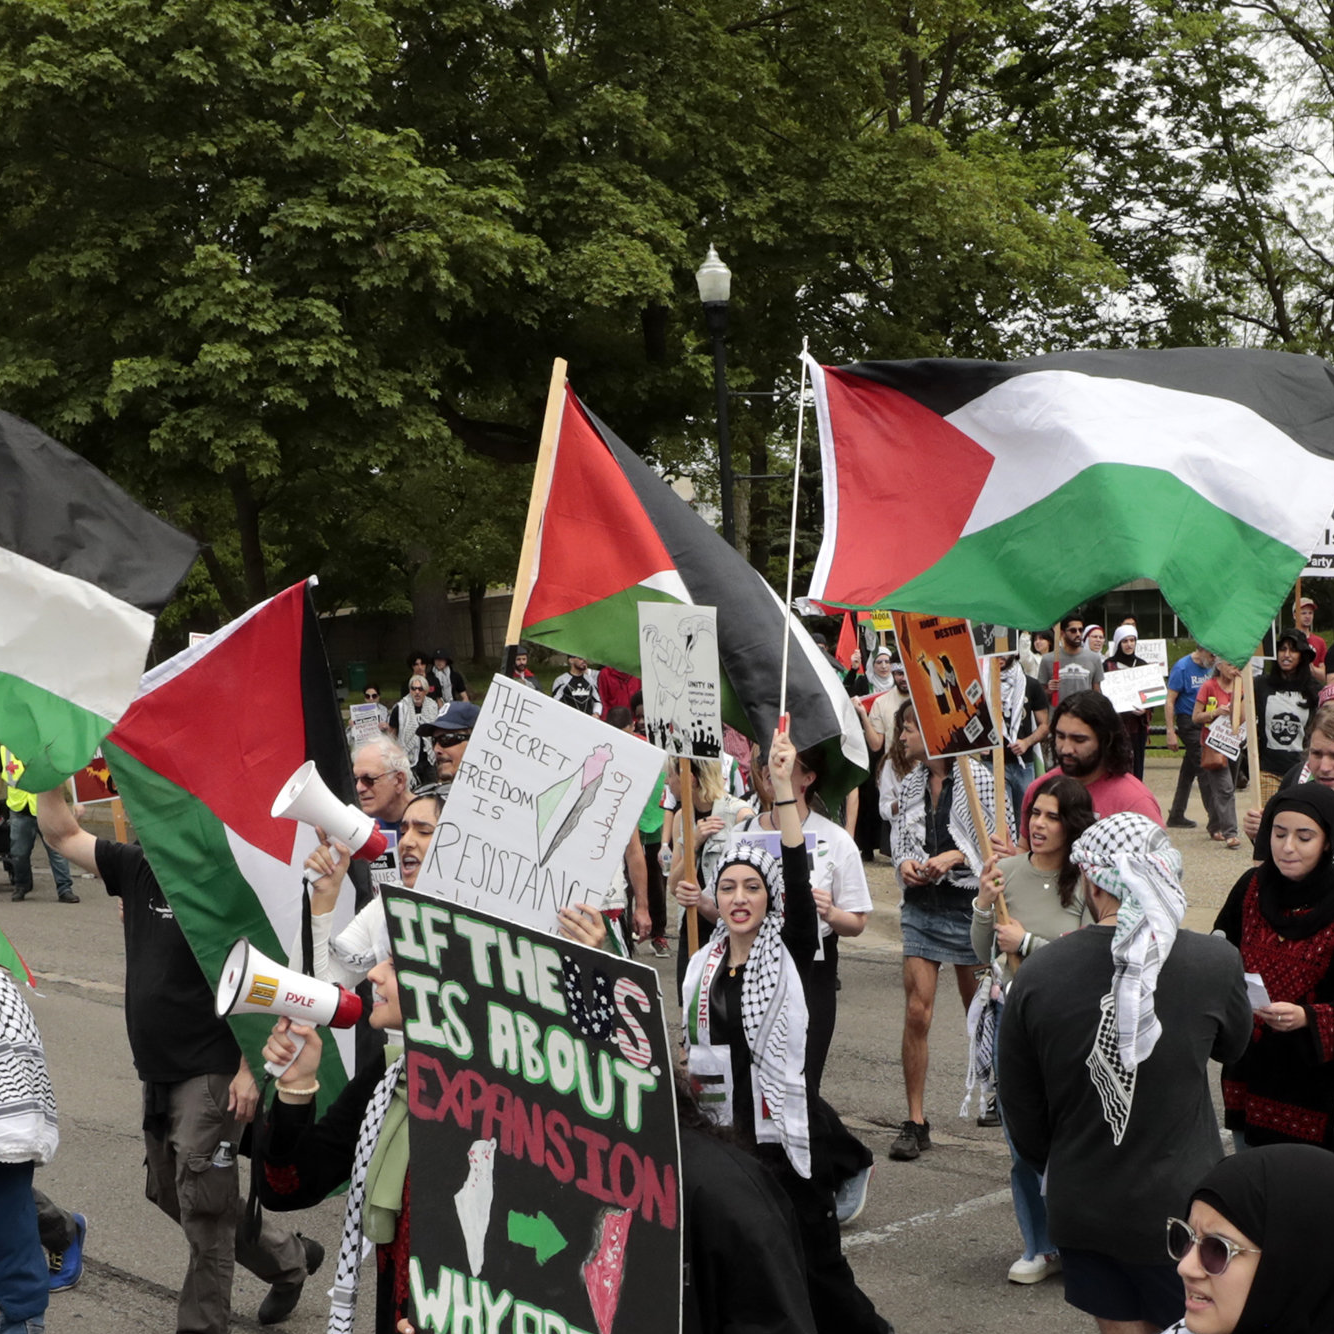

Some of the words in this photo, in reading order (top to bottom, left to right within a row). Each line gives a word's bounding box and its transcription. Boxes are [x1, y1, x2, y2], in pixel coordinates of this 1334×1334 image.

[490, 680, 542, 728] THE
[688, 681, 706, 689] UNITY
[480, 749, 503, 771] TO
[487, 720, 572, 771] SECRET
[458, 760, 534, 811] FREEDOM
[471, 795, 505, 821] IS
[387, 897, 452, 972] IF
[453, 913, 568, 1017] THE
[284, 991, 316, 1008] PYLE
[397, 969, 474, 1061] IS
[487, 1001, 659, 1134] ABOUT
[407, 1050, 677, 1230] EXPANSION
